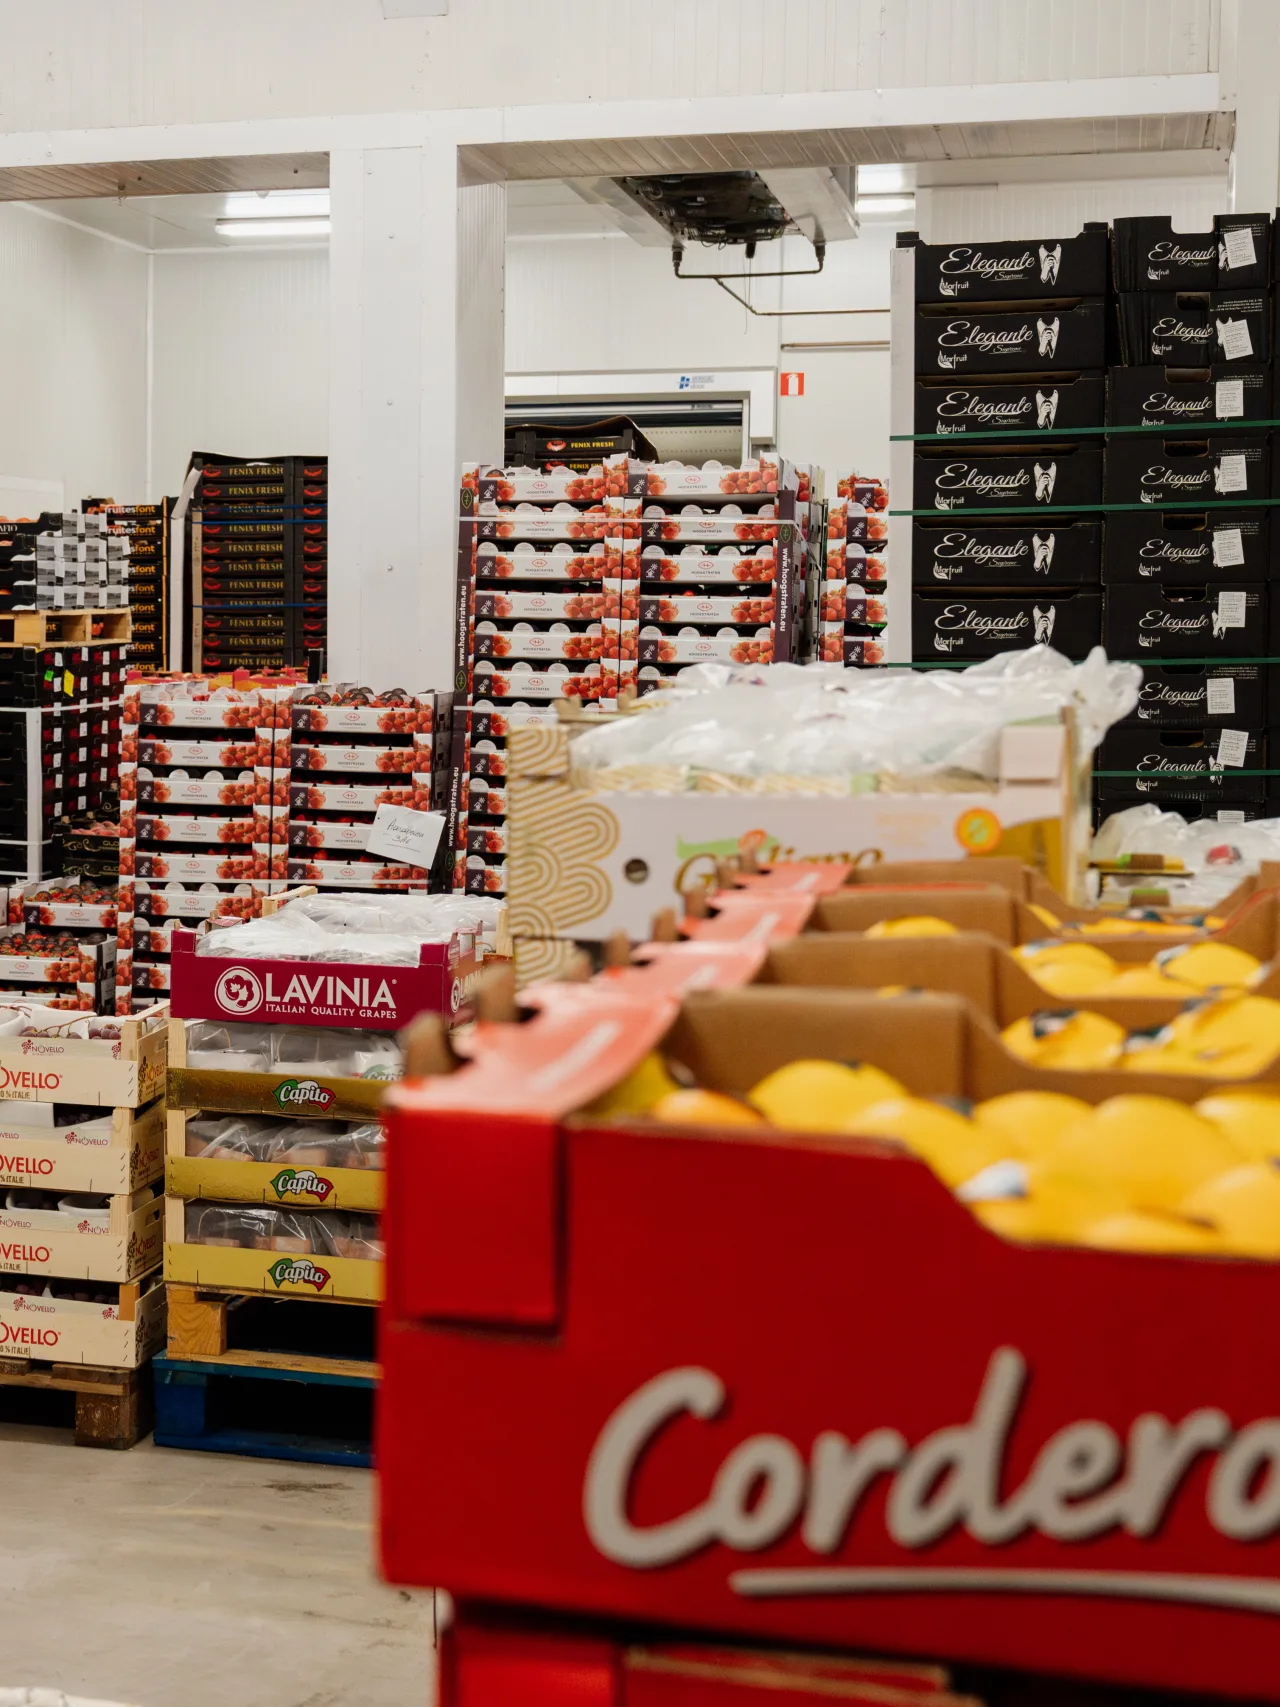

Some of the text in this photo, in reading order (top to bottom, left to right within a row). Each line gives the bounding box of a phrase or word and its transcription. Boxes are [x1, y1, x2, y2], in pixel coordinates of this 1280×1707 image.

[940, 247, 1036, 279] Elegante
[1148, 241, 1217, 265] Elegante
[938, 317, 1033, 352] Elegante
[936, 391, 1032, 423] Elegante
[1143, 393, 1213, 418] Elegante
[229, 466, 284, 476] FENIX FRESH
[935, 463, 1030, 497] Elegante
[1141, 466, 1211, 490] Elegante
[229, 486, 284, 495] FENIX FRESH
[229, 524, 284, 533] FENIX FRESH
[229, 543, 284, 552] FENIX FRESH
[934, 533, 1029, 564] Elegante
[1140, 539, 1209, 564] Elegante
[229, 562, 284, 572] FENIX FRESH
[229, 581, 284, 590] FENIX FRESH
[934, 605, 1030, 636] Elegante
[1140, 611, 1209, 635] Elegante
[1138, 682, 1207, 707] Elegante
[265, 972, 397, 1009] LAVINIA
[265, 1003, 397, 1019] ITALIAN QUALITY GRAPES
[32, 1046, 64, 1054] NOVELLO
[279, 1085, 330, 1104] Capito
[76, 1137, 108, 1146] NOVELLO
[277, 1175, 328, 1194] Capito
[0, 1218, 32, 1228] NOVELLO
[275, 1264, 325, 1283] Capito
[23, 1303, 56, 1313] NOVELLO
[582, 1345, 1280, 1569] Cordero
